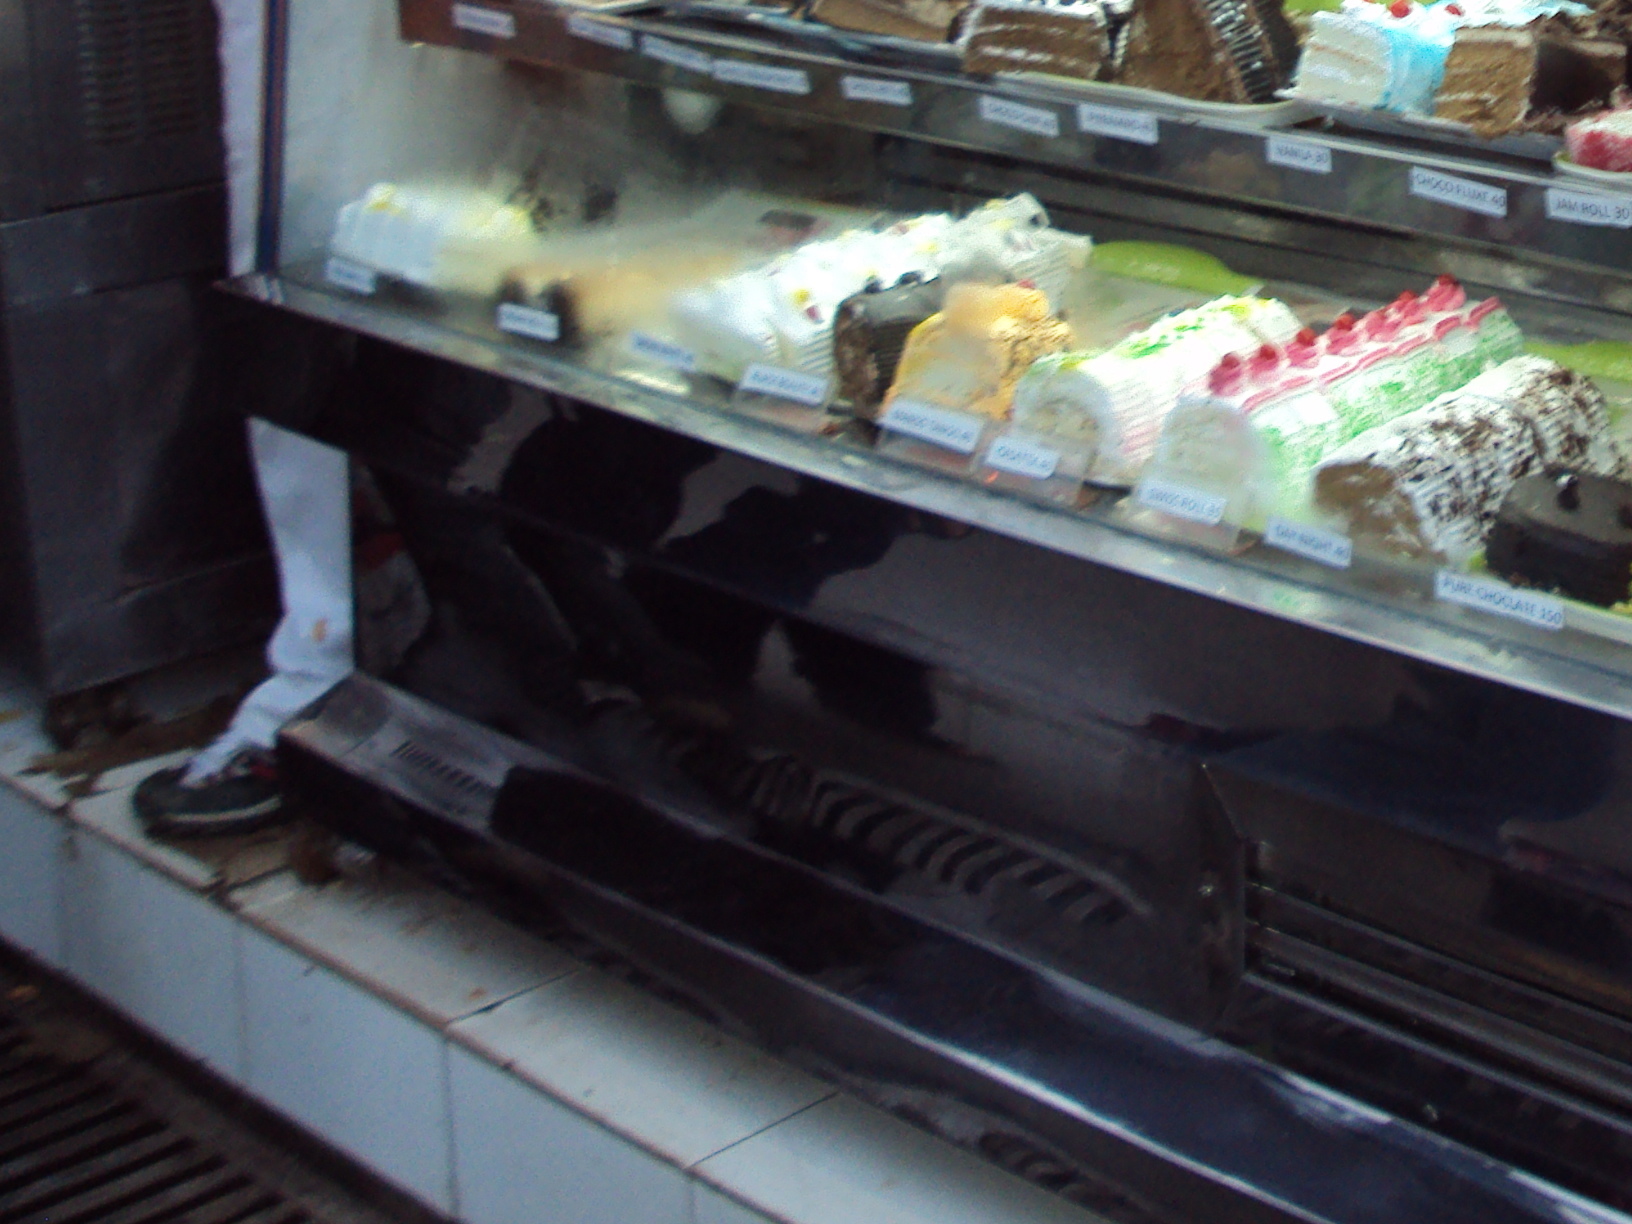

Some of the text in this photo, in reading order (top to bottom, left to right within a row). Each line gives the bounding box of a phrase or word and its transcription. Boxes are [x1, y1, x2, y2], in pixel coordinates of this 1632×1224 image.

[1555, 197, 1630, 220] JAM ROLL 30
[1540, 607, 1562, 625] 150
